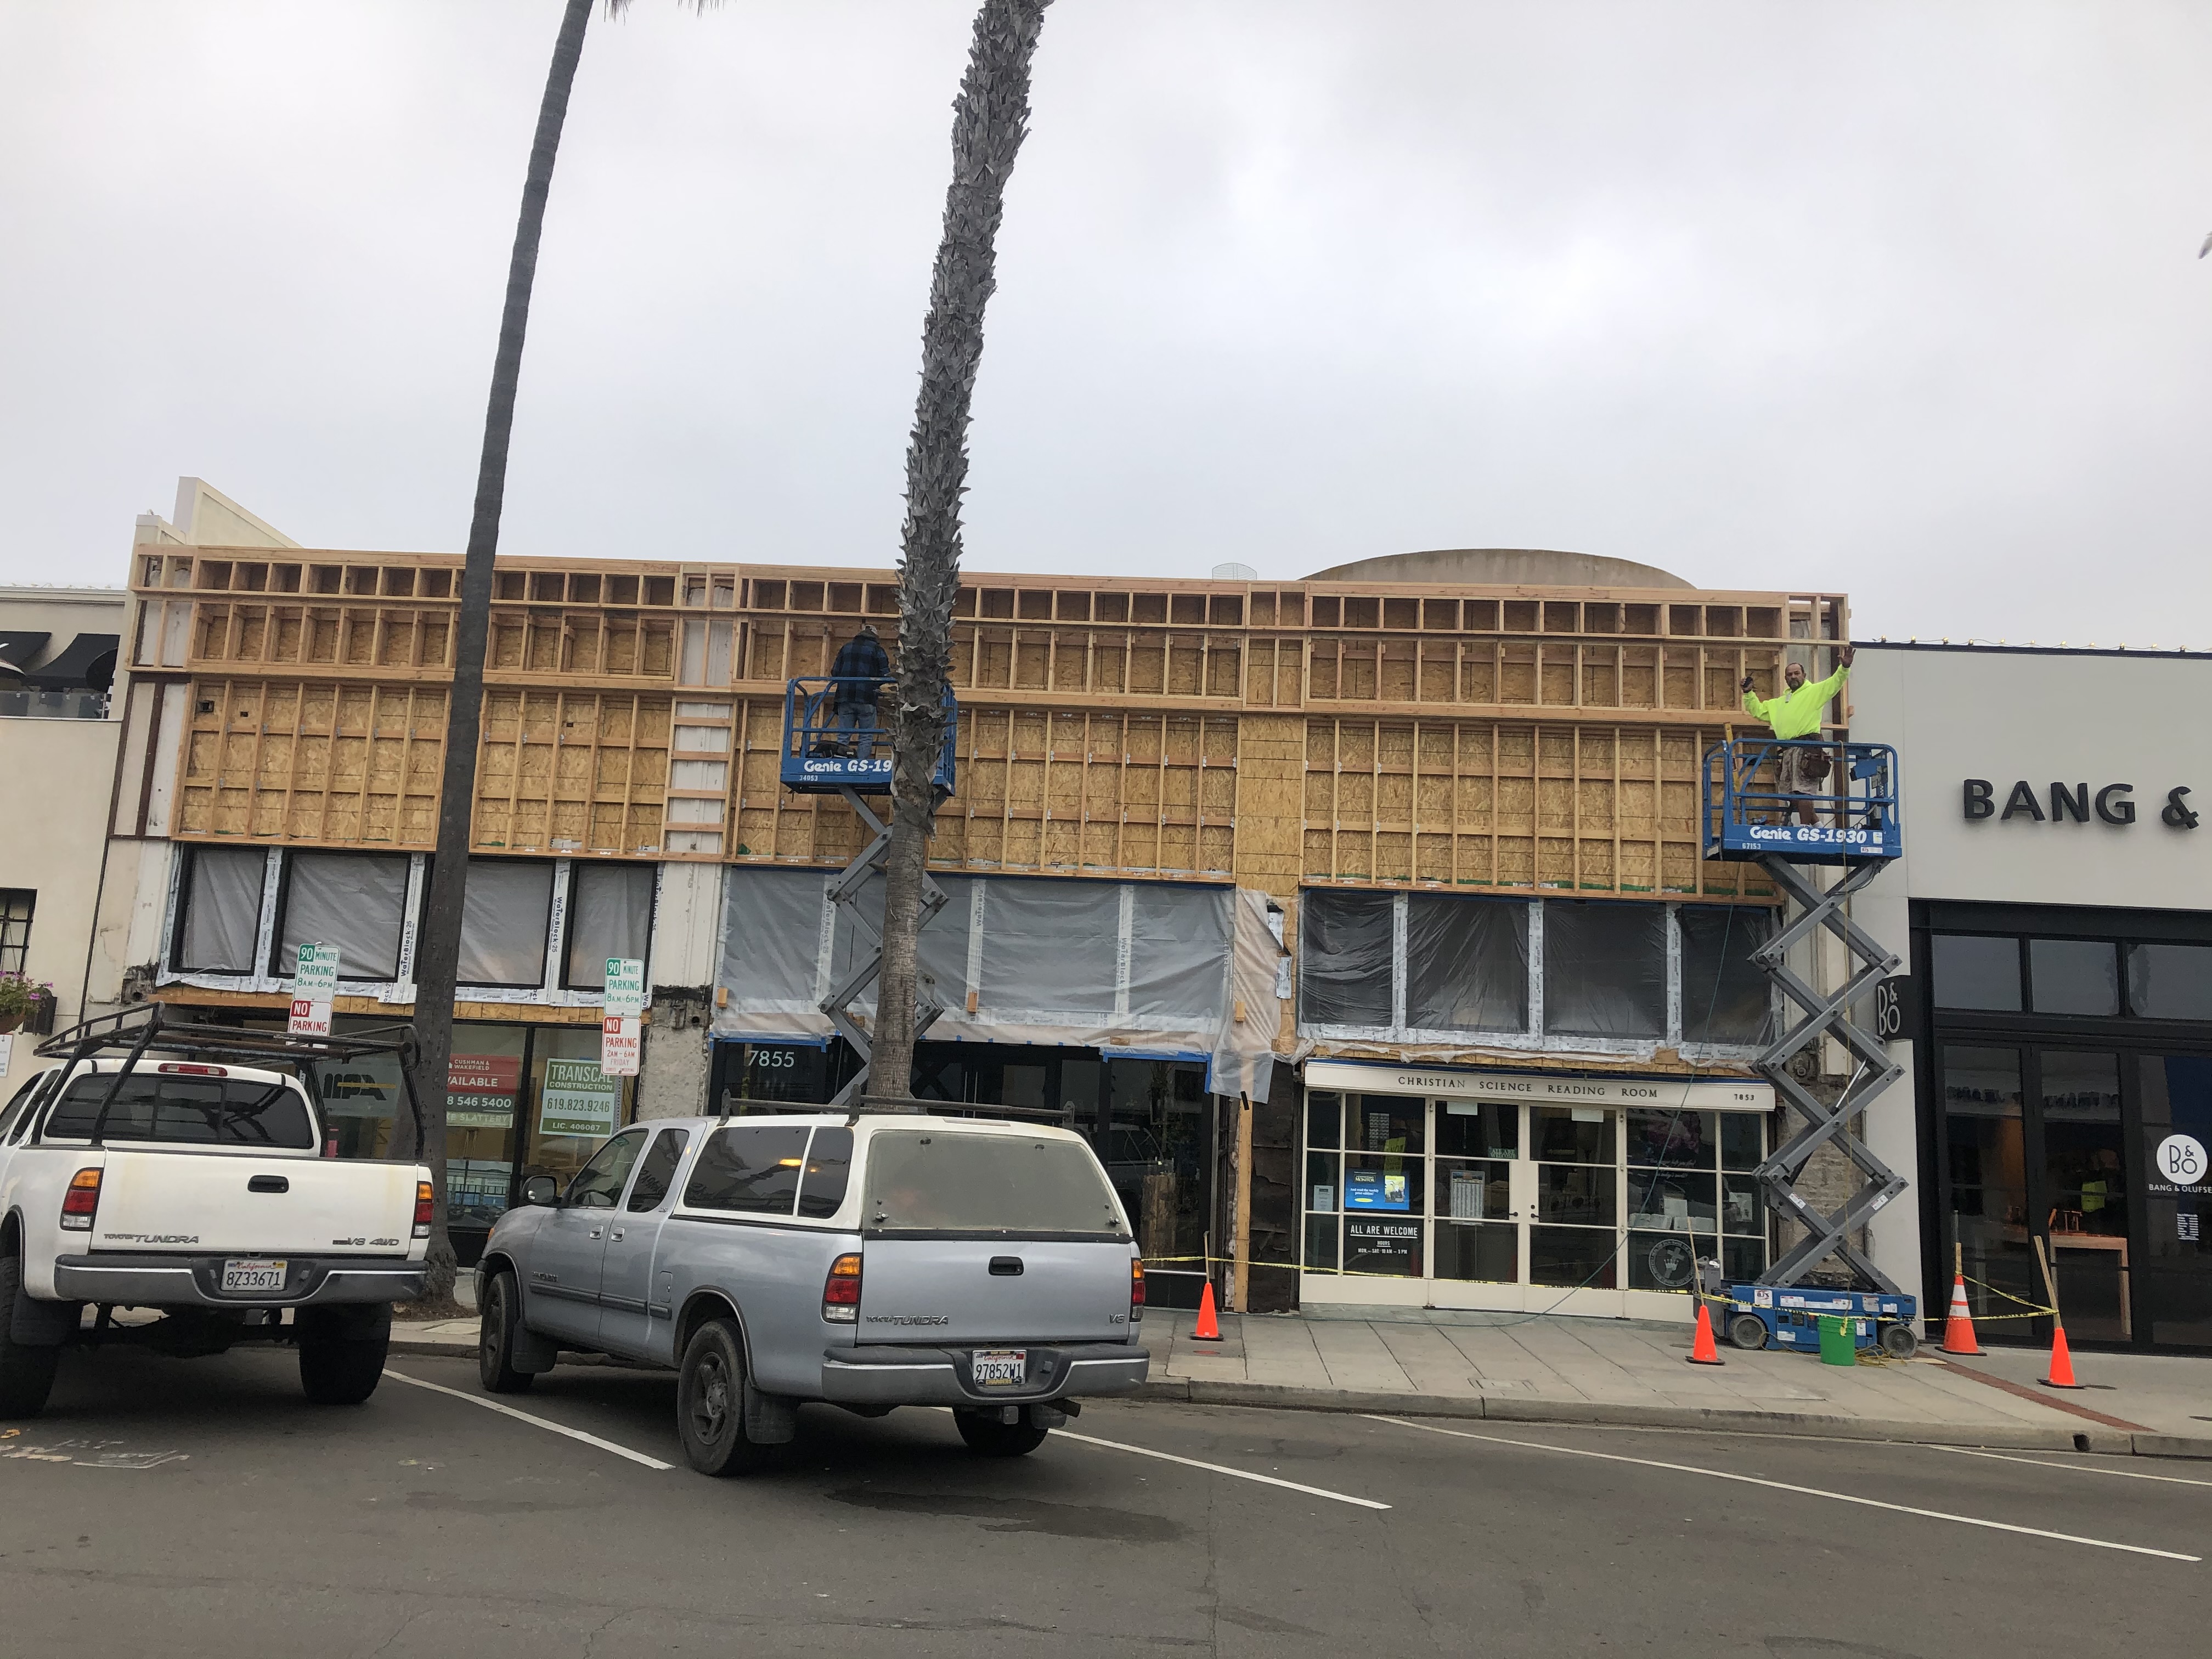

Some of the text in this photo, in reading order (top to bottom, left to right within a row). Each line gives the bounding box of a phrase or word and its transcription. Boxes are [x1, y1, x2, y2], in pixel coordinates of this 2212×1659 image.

[804, 760, 893, 772] Genie GS-19
[1963, 778, 2200, 830] BANG &
[1750, 827, 1867, 844] Genie GS-1930
[300, 947, 337, 961] 90 MINUTE
[300, 964, 334, 977] PARKING
[608, 962, 638, 974] 90 MINUTE
[609, 979, 639, 991] PARKING
[294, 1003, 308, 1015] NO
[292, 1020, 327, 1032] PARKING
[606, 1019, 618, 1032] NO
[606, 1037, 636, 1048] PARKING
[748, 1050, 794, 1068] 7855
[551, 1064, 613, 1083] TRANSCAL
[549, 1081, 613, 1091] CONSTRUCTION
[1398, 1076, 1657, 1097] CHRISTIAN SCIENCE READING ROOM
[457, 1096, 478, 1106] 546
[481, 1098, 511, 1108] 5400
[547, 1097, 610, 1113] 619.823.9246
[460, 1114, 507, 1122] SLATTERY
[1350, 1225, 1418, 1236] ALL ARE WELCOME
[134, 1234, 199, 1244] TUNDRA
[226, 1271, 280, 1286] 8Z33671
[893, 1316, 949, 1325] TUNDRA
[1109, 1314, 1125, 1324] V8
[975, 1363, 1022, 1380] 97852W1
